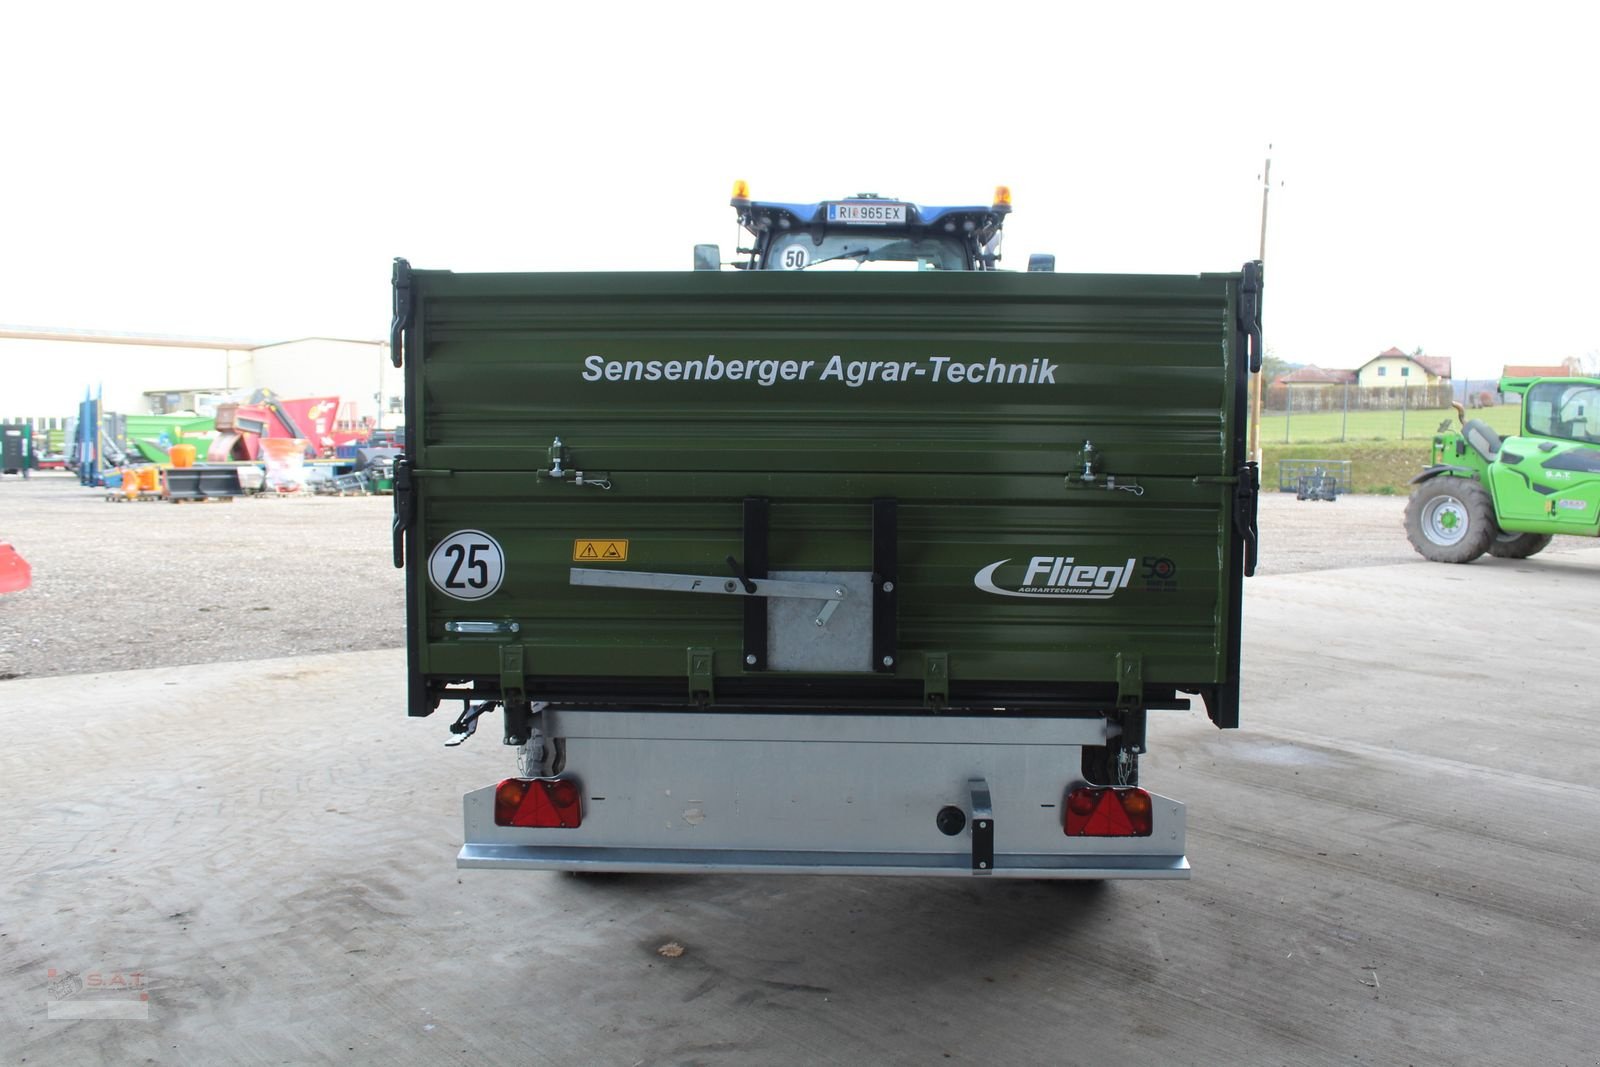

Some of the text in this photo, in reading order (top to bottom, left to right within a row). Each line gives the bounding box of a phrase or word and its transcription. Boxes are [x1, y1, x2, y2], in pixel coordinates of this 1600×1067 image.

[839, 206, 900, 219] RI 965 EX
[786, 249, 804, 268] 50
[582, 354, 1058, 388] Sensenberger Agrar-Technik
[445, 543, 490, 589] 25
[1022, 556, 1137, 594] Fliegl
